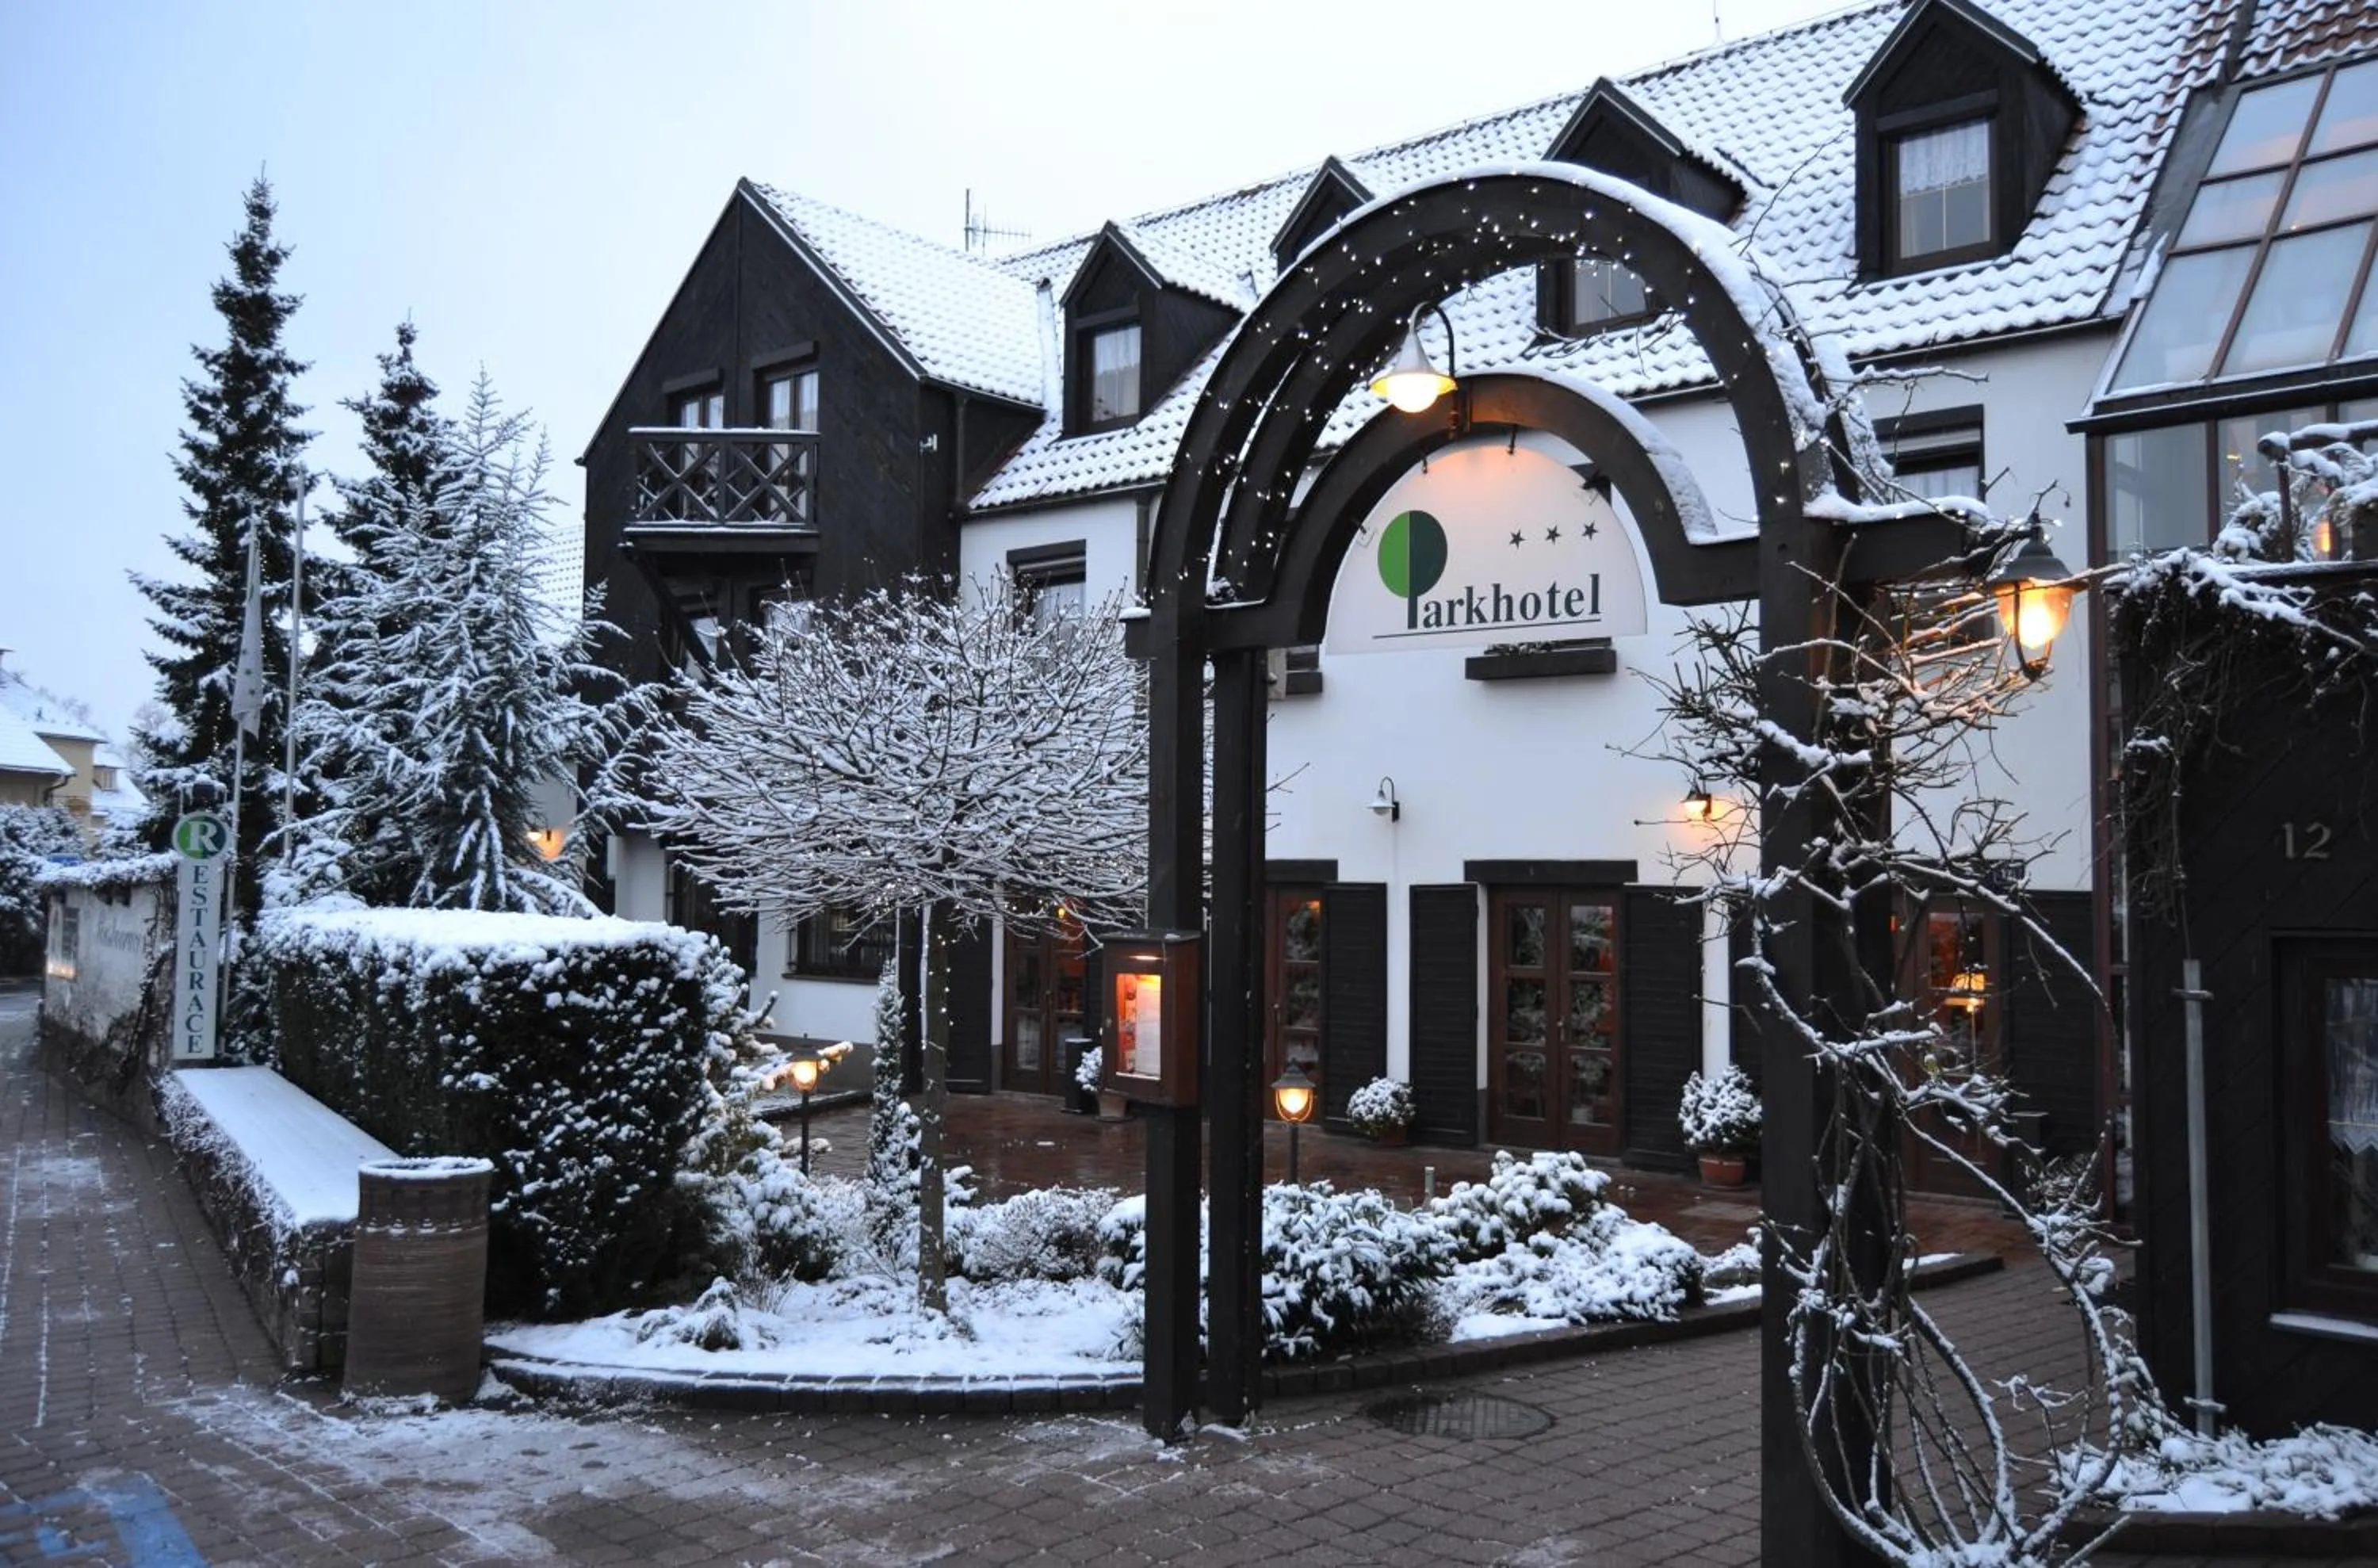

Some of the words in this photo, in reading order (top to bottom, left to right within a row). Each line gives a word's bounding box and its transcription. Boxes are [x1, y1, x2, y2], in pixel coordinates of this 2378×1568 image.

[1378, 510, 1601, 629] Parkhotel
[2283, 822, 2331, 859] 12
[185, 820, 219, 1054] RESTAURACE
